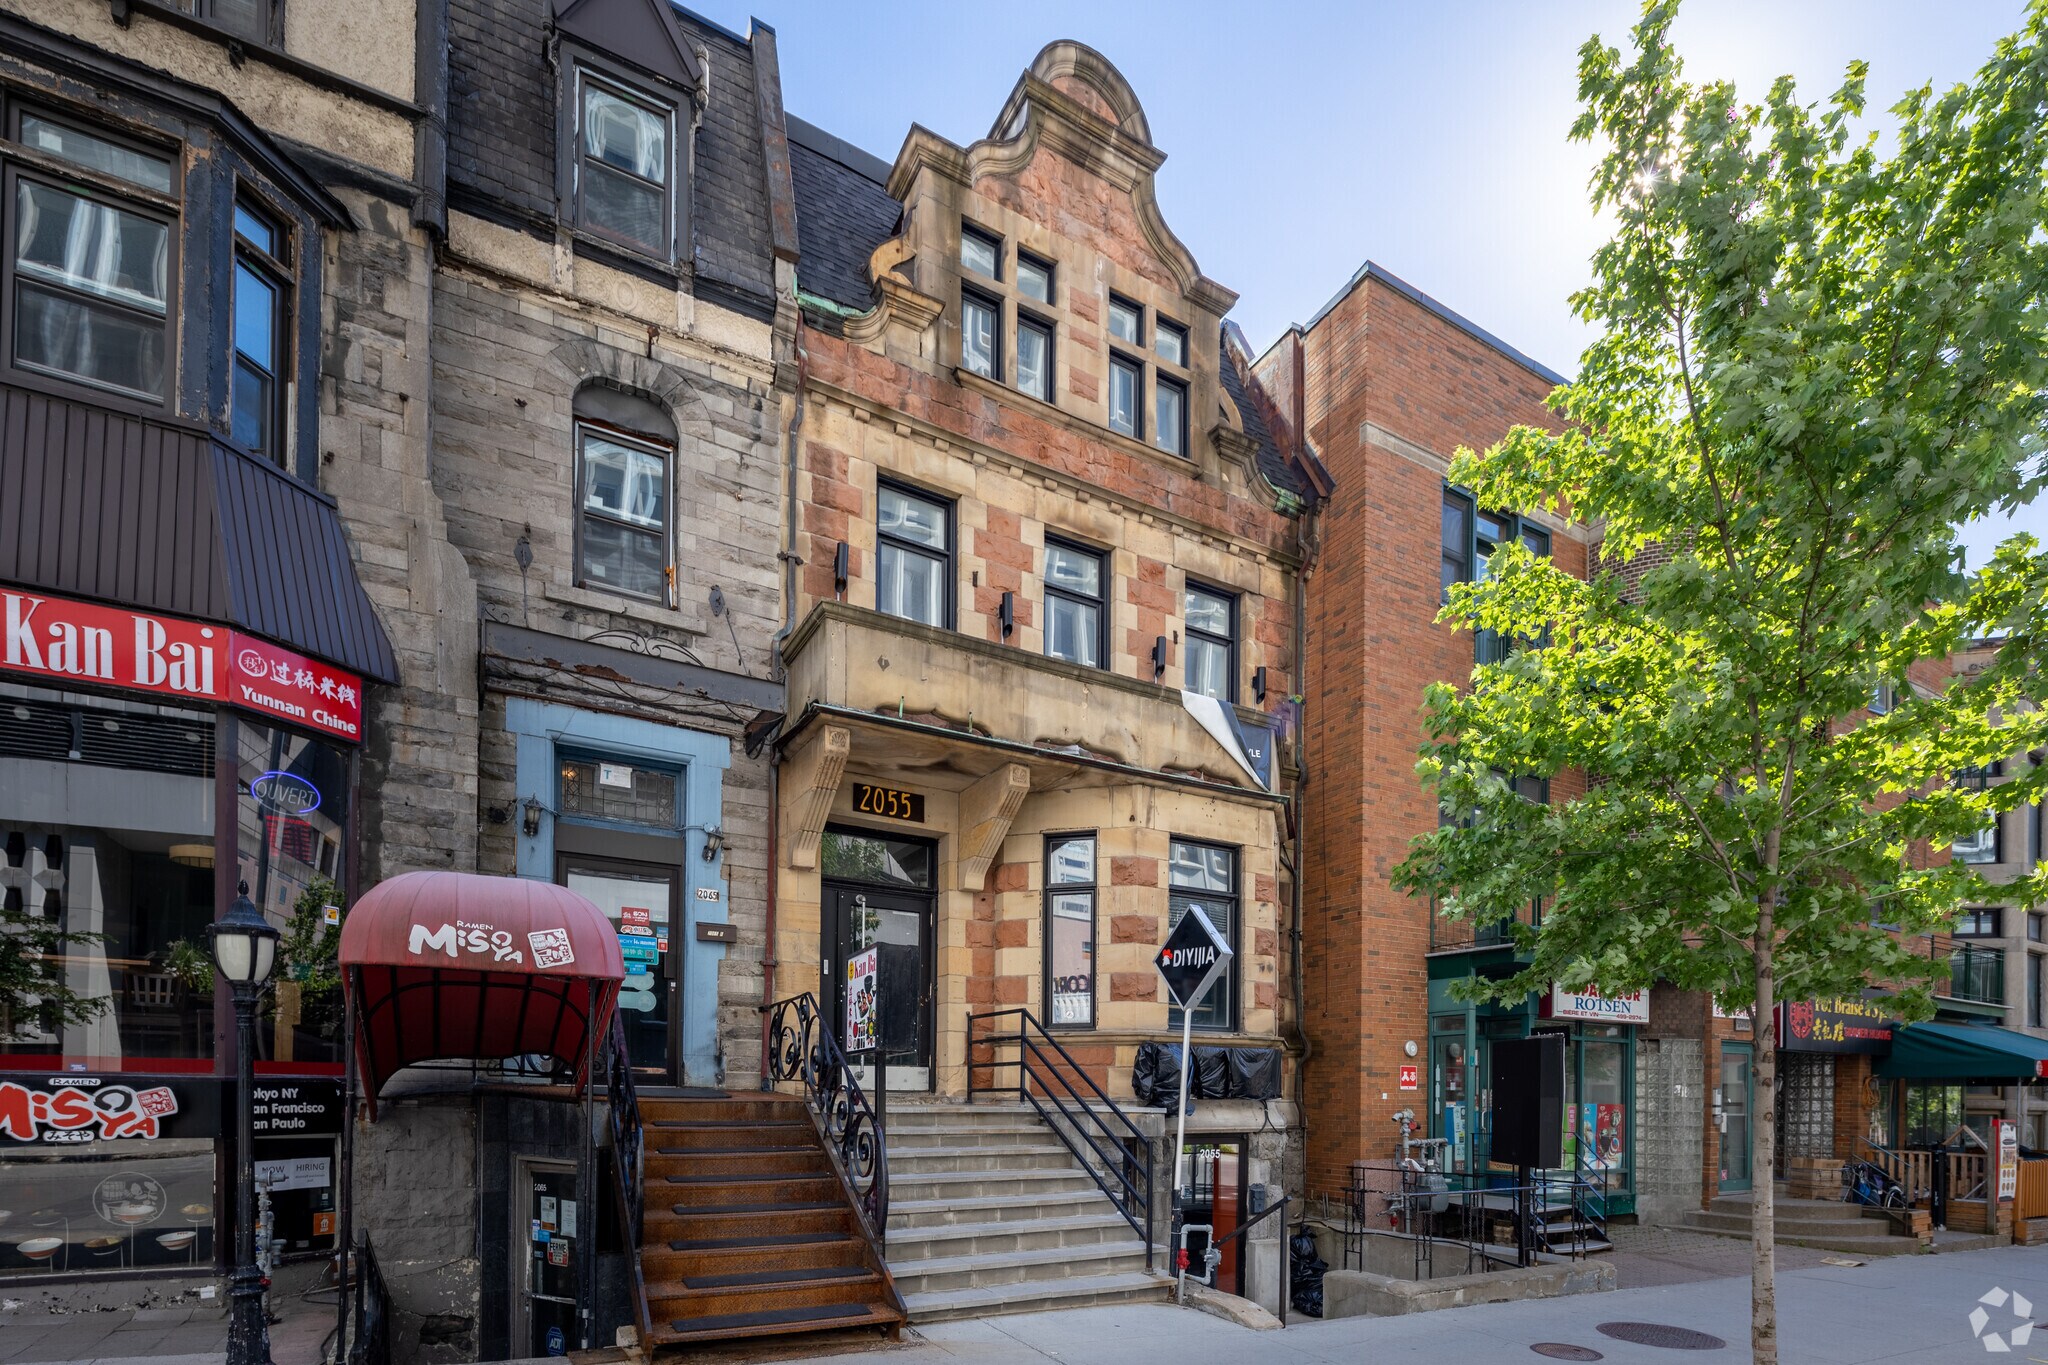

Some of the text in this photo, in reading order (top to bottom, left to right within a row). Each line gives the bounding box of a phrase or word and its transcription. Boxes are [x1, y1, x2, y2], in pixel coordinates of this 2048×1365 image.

[1, 593, 217, 696] Kan Bai
[270, 660, 357, 709] 过桥米线
[240, 684, 357, 734] Yunnan Chine
[256, 781, 316, 808] OUVERT
[859, 784, 912, 818] 2055
[456, 920, 494, 931] RAMEN
[1172, 945, 1216, 969] DIYIJIA
[1574, 997, 1632, 1014] ROTSEN
[53, 1078, 98, 1086] RAMEN
[281, 1088, 299, 1099] NY
[254, 1102, 325, 1115] an Francisco
[254, 1118, 306, 1130] an Paulo
[1199, 1148, 1221, 1159] 2055
[296, 1162, 325, 1171] HIRING
[548, 1337, 562, 1350] ADT
